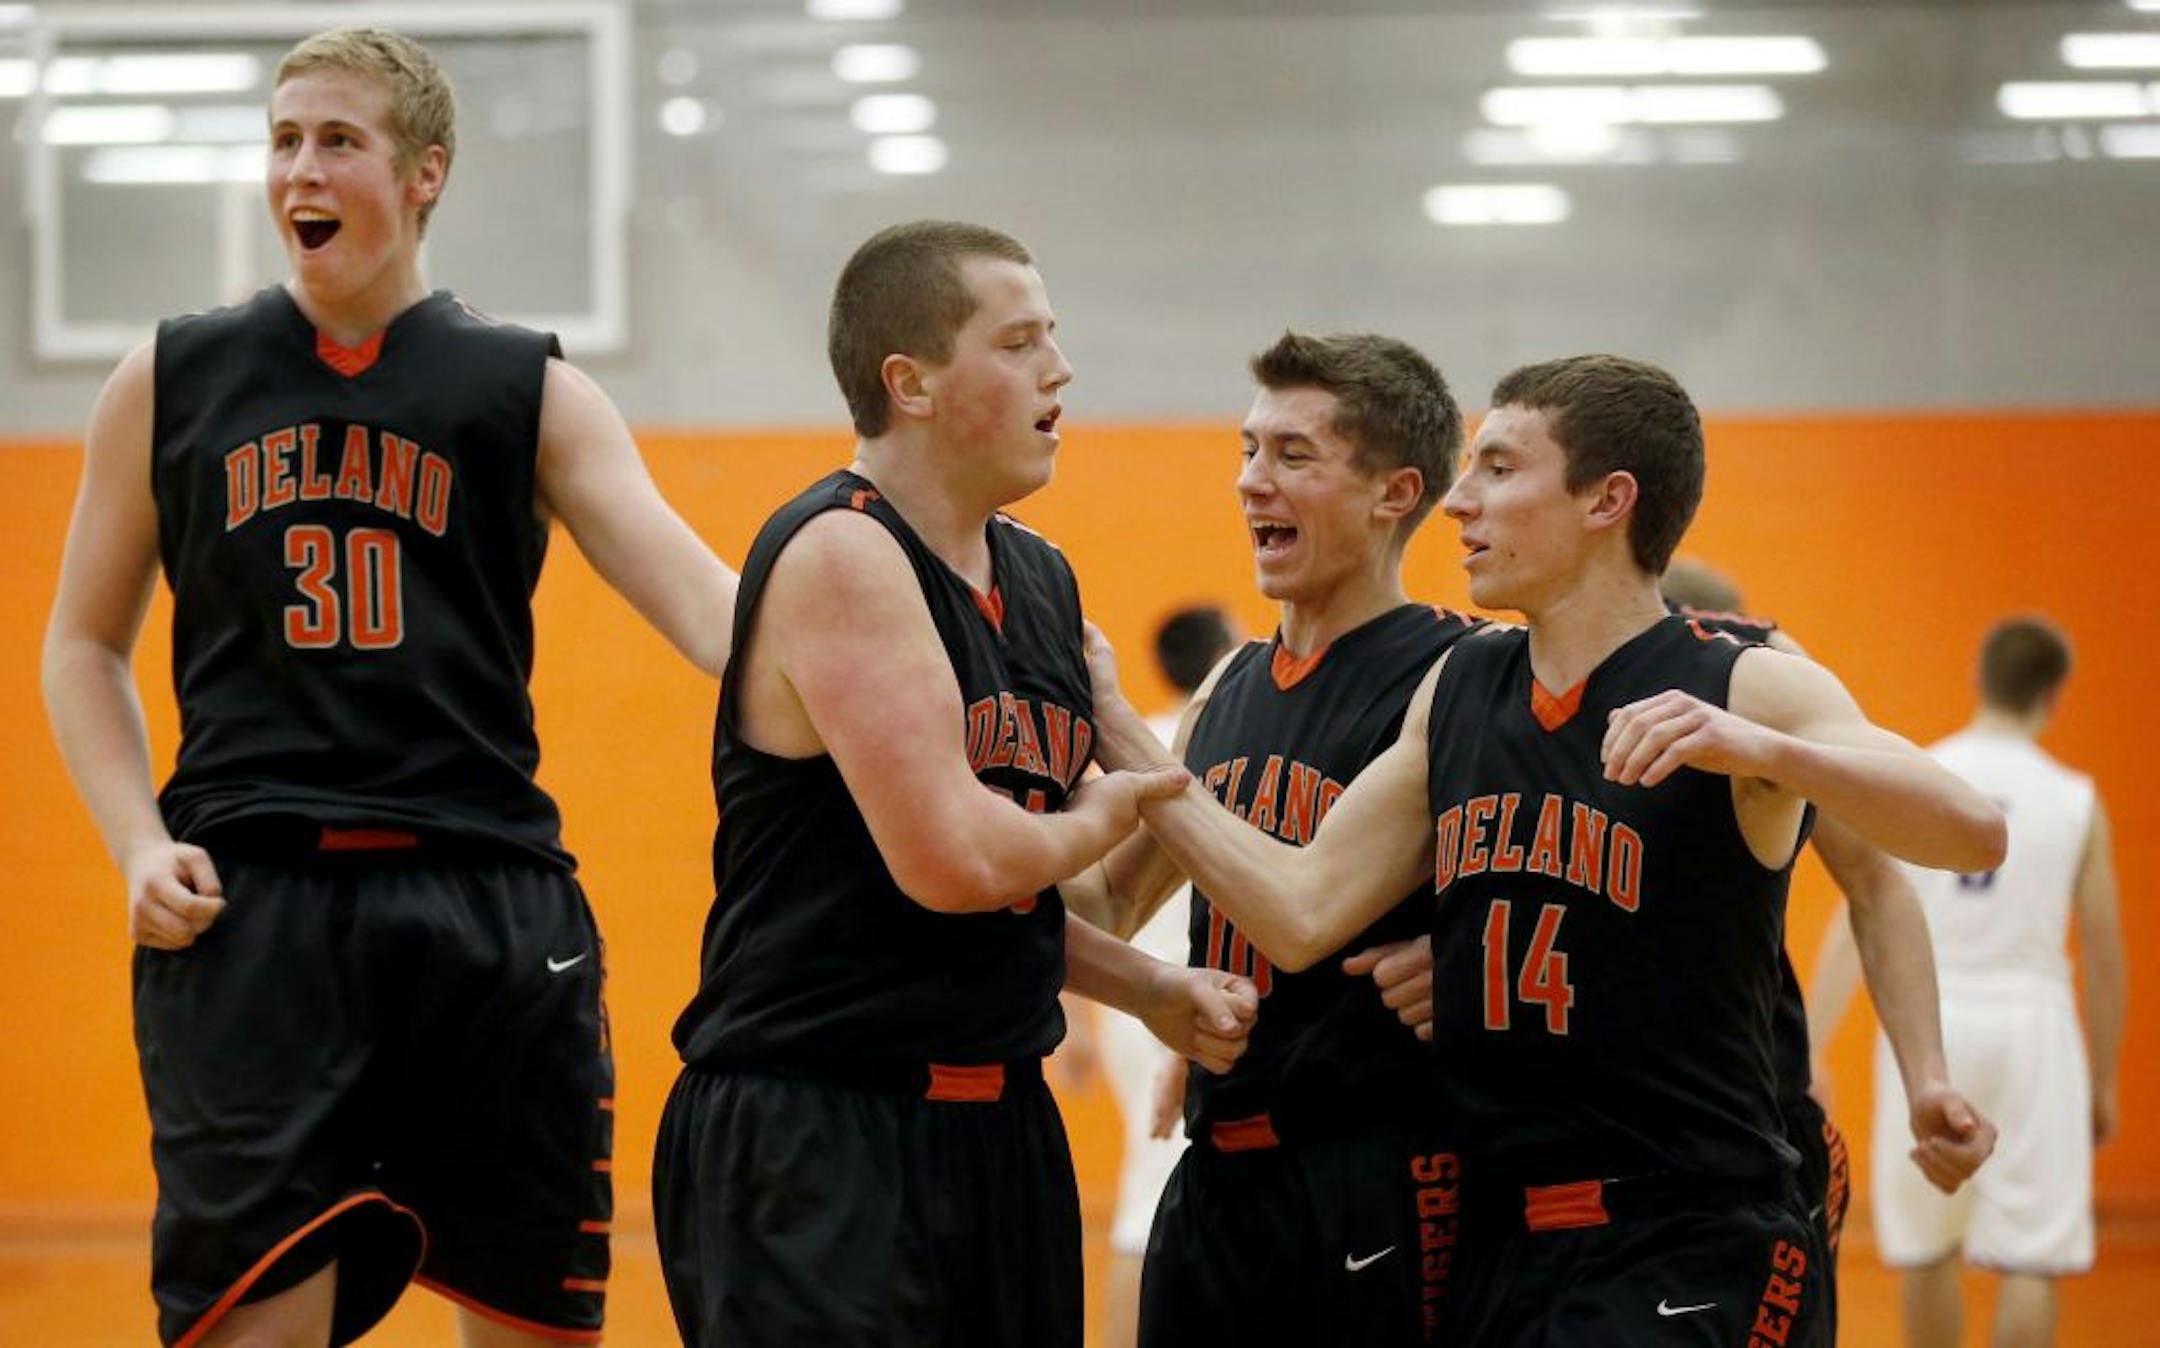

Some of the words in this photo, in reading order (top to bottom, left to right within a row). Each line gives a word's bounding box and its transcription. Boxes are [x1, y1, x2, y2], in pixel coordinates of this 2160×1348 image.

[225, 423, 453, 537] DELANO
[284, 524, 404, 650] 30
[965, 690, 1093, 791] DEANO
[1200, 754, 1346, 845] ELANO
[1434, 792, 1644, 913] DELANO
[1482, 898, 1575, 1035] 14
